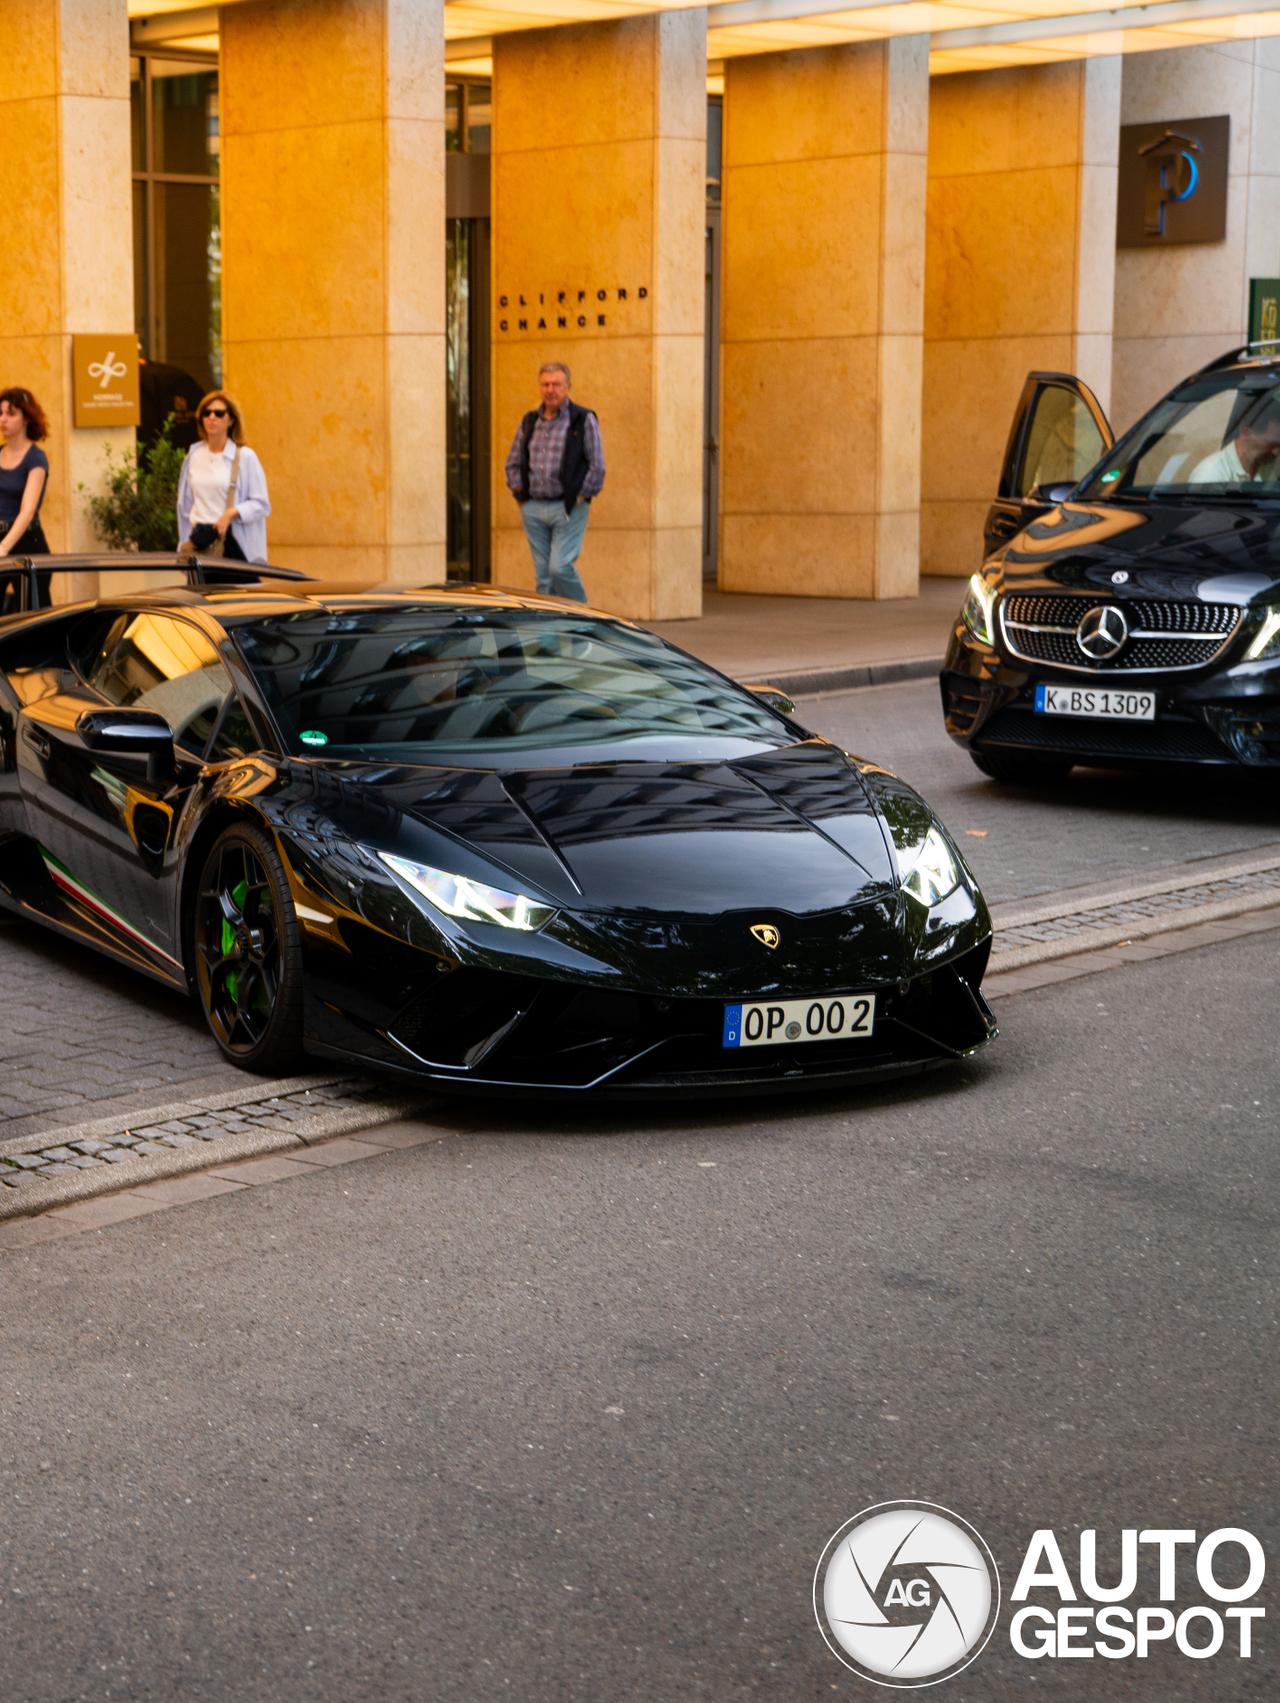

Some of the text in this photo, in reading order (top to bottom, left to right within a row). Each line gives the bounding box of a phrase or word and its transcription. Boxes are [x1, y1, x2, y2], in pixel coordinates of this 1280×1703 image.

[499, 286, 648, 308] CLIFFORD
[499, 314, 606, 332] CHANCE
[1046, 690, 1058, 711] K
[744, 1006, 785, 1041] OP
[728, 1031, 736, 1041] D
